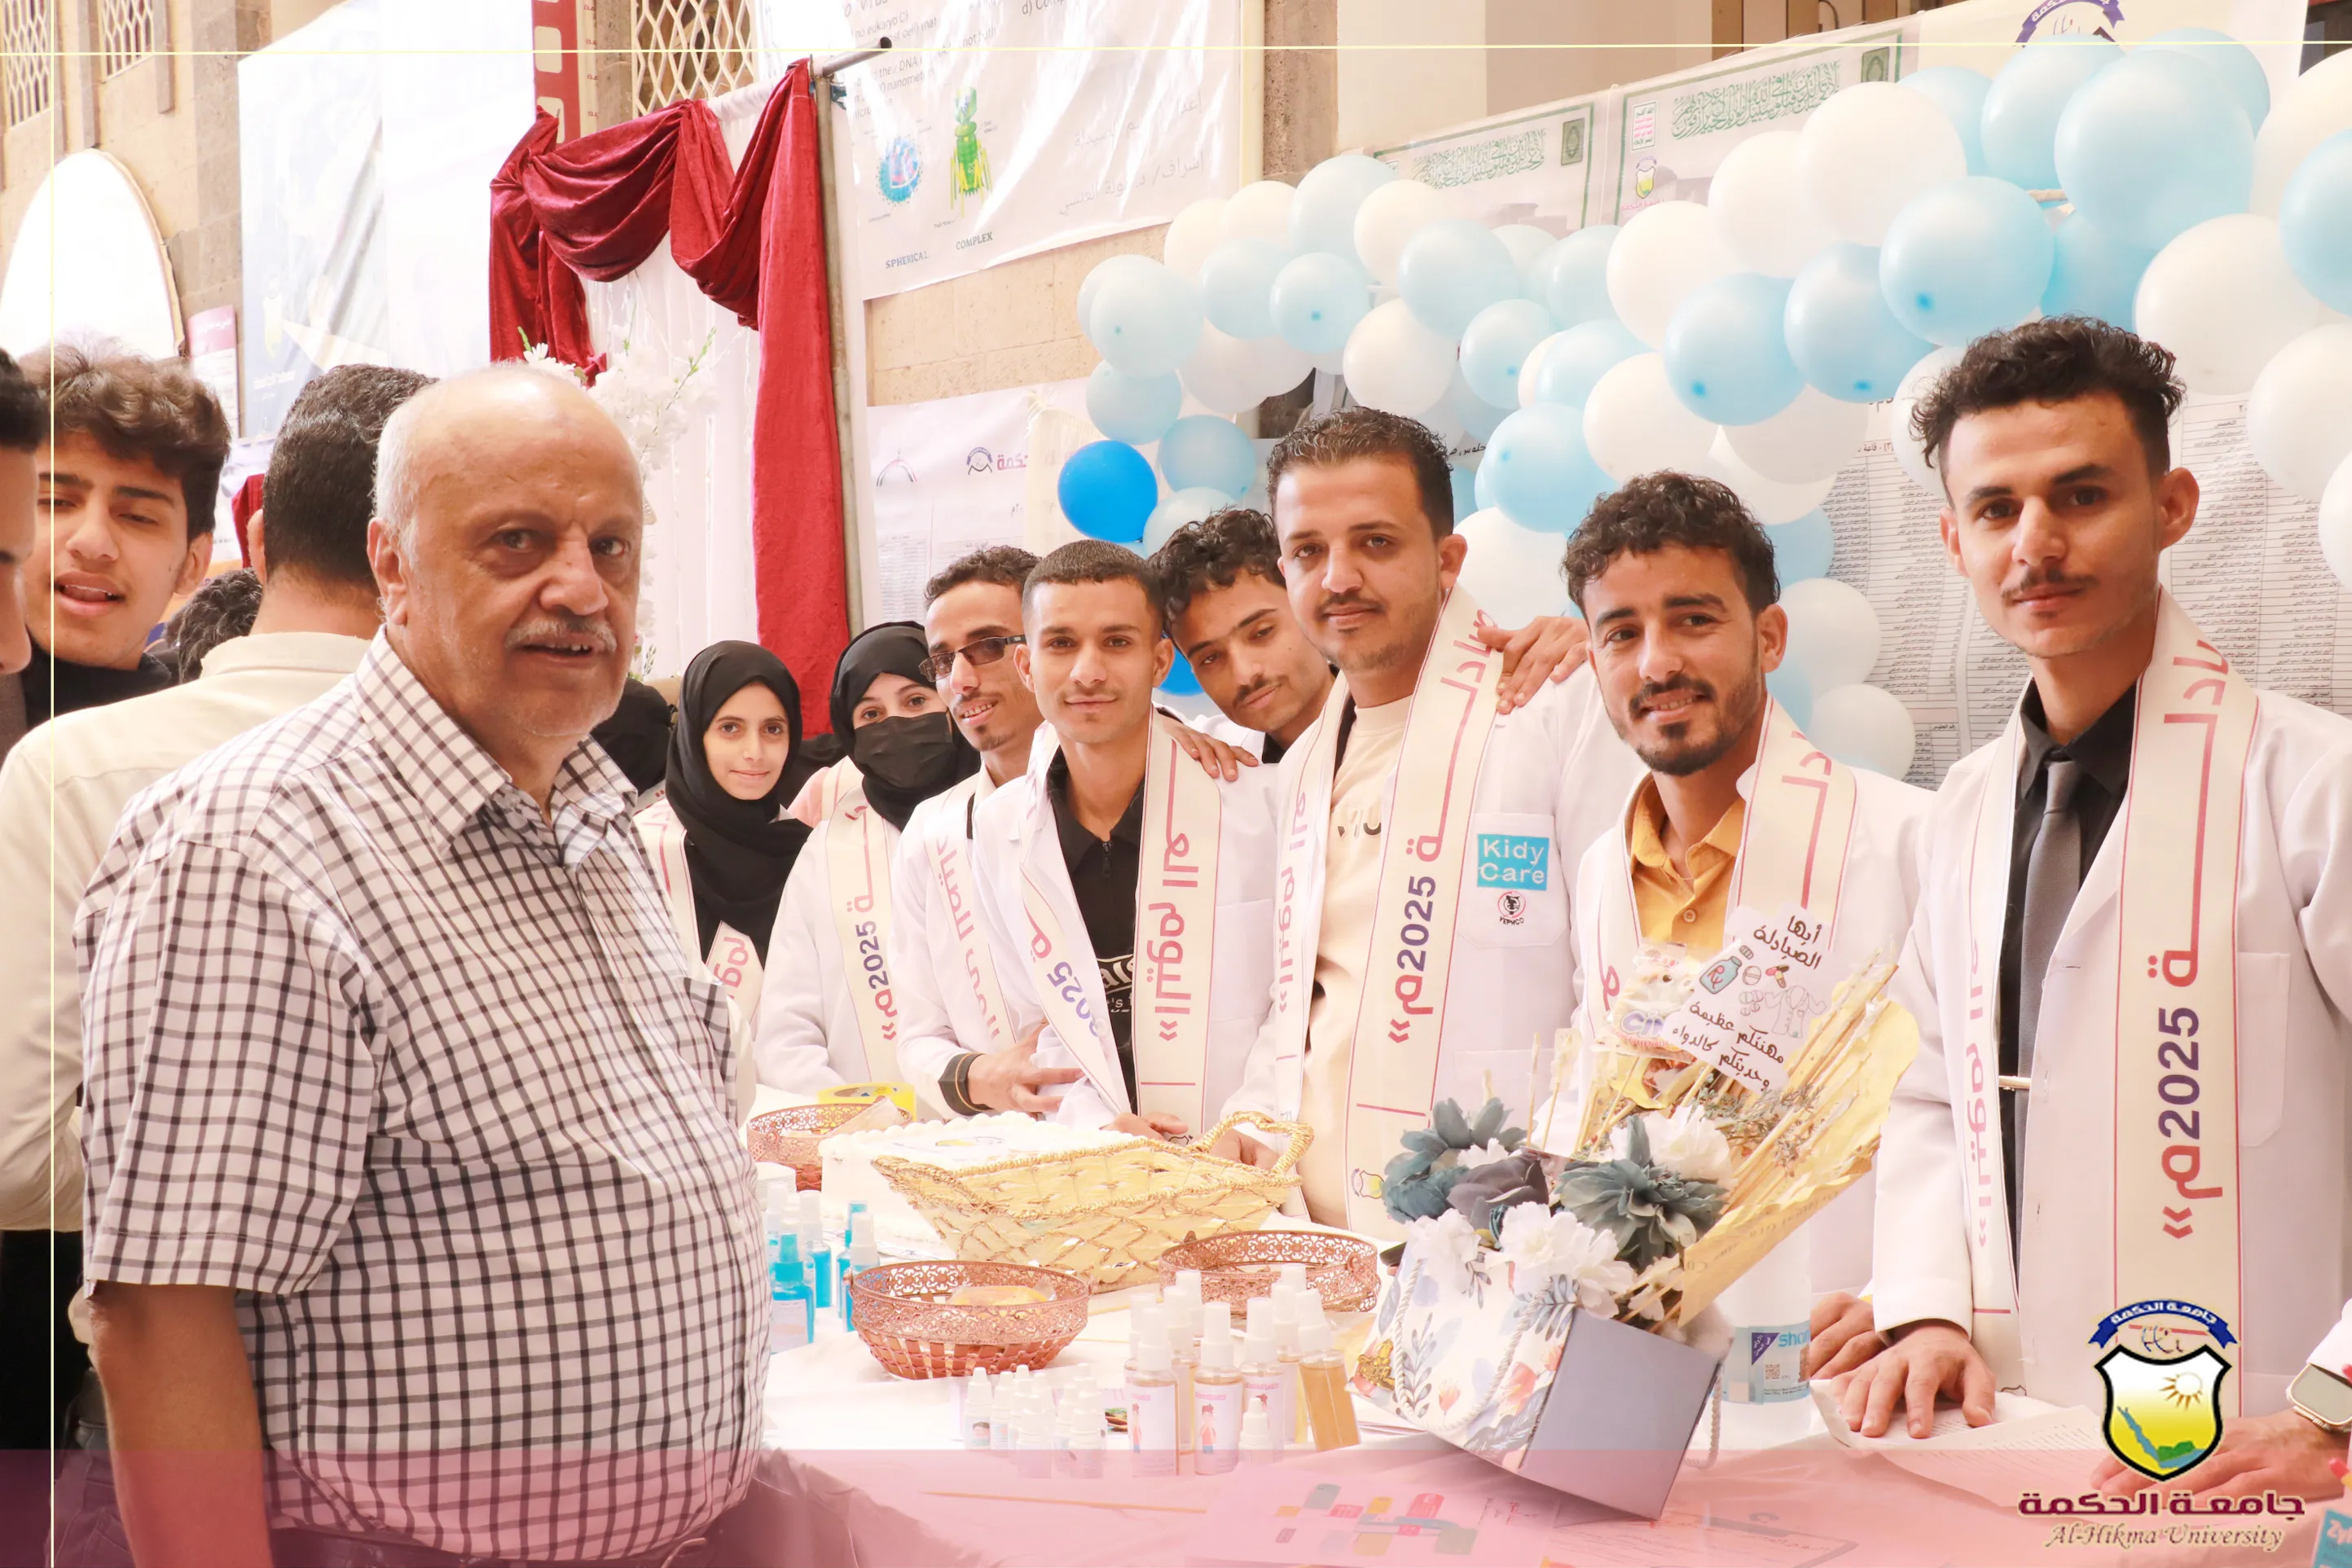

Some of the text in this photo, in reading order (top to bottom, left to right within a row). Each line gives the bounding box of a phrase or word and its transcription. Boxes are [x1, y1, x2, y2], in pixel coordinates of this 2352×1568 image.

[899, 56, 918, 73] DNA
[955, 231, 994, 251] COMPLEX
[885, 250, 930, 270] SPHERICAL
[1483, 839, 1545, 866] Kidy
[1479, 862, 1545, 885] Care
[1753, 925, 1822, 970] الصيادلة
